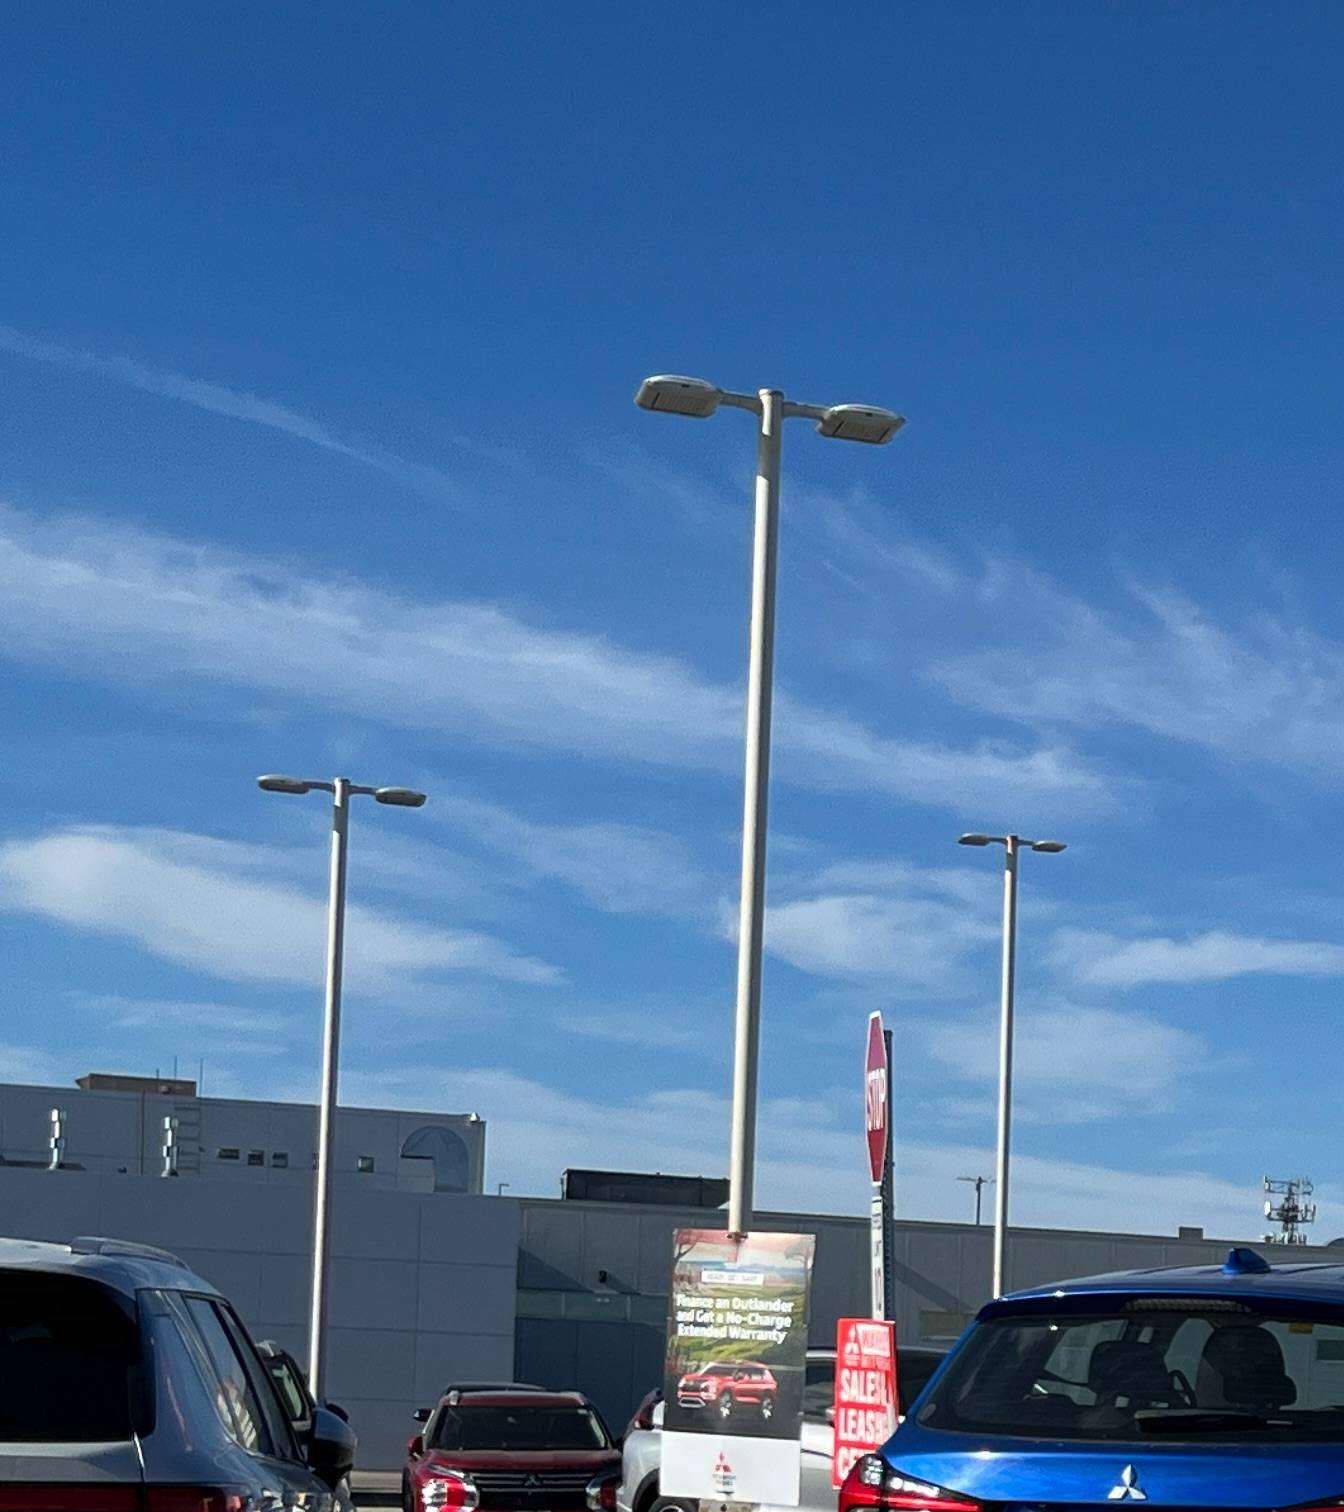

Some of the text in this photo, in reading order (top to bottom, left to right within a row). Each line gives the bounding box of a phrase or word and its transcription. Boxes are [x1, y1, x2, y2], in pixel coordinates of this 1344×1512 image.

[676, 1294, 794, 1312] Finance an Outlander
[726, 1311, 792, 1329] No-Charge
[678, 1323, 788, 1344] Extended Warranty
